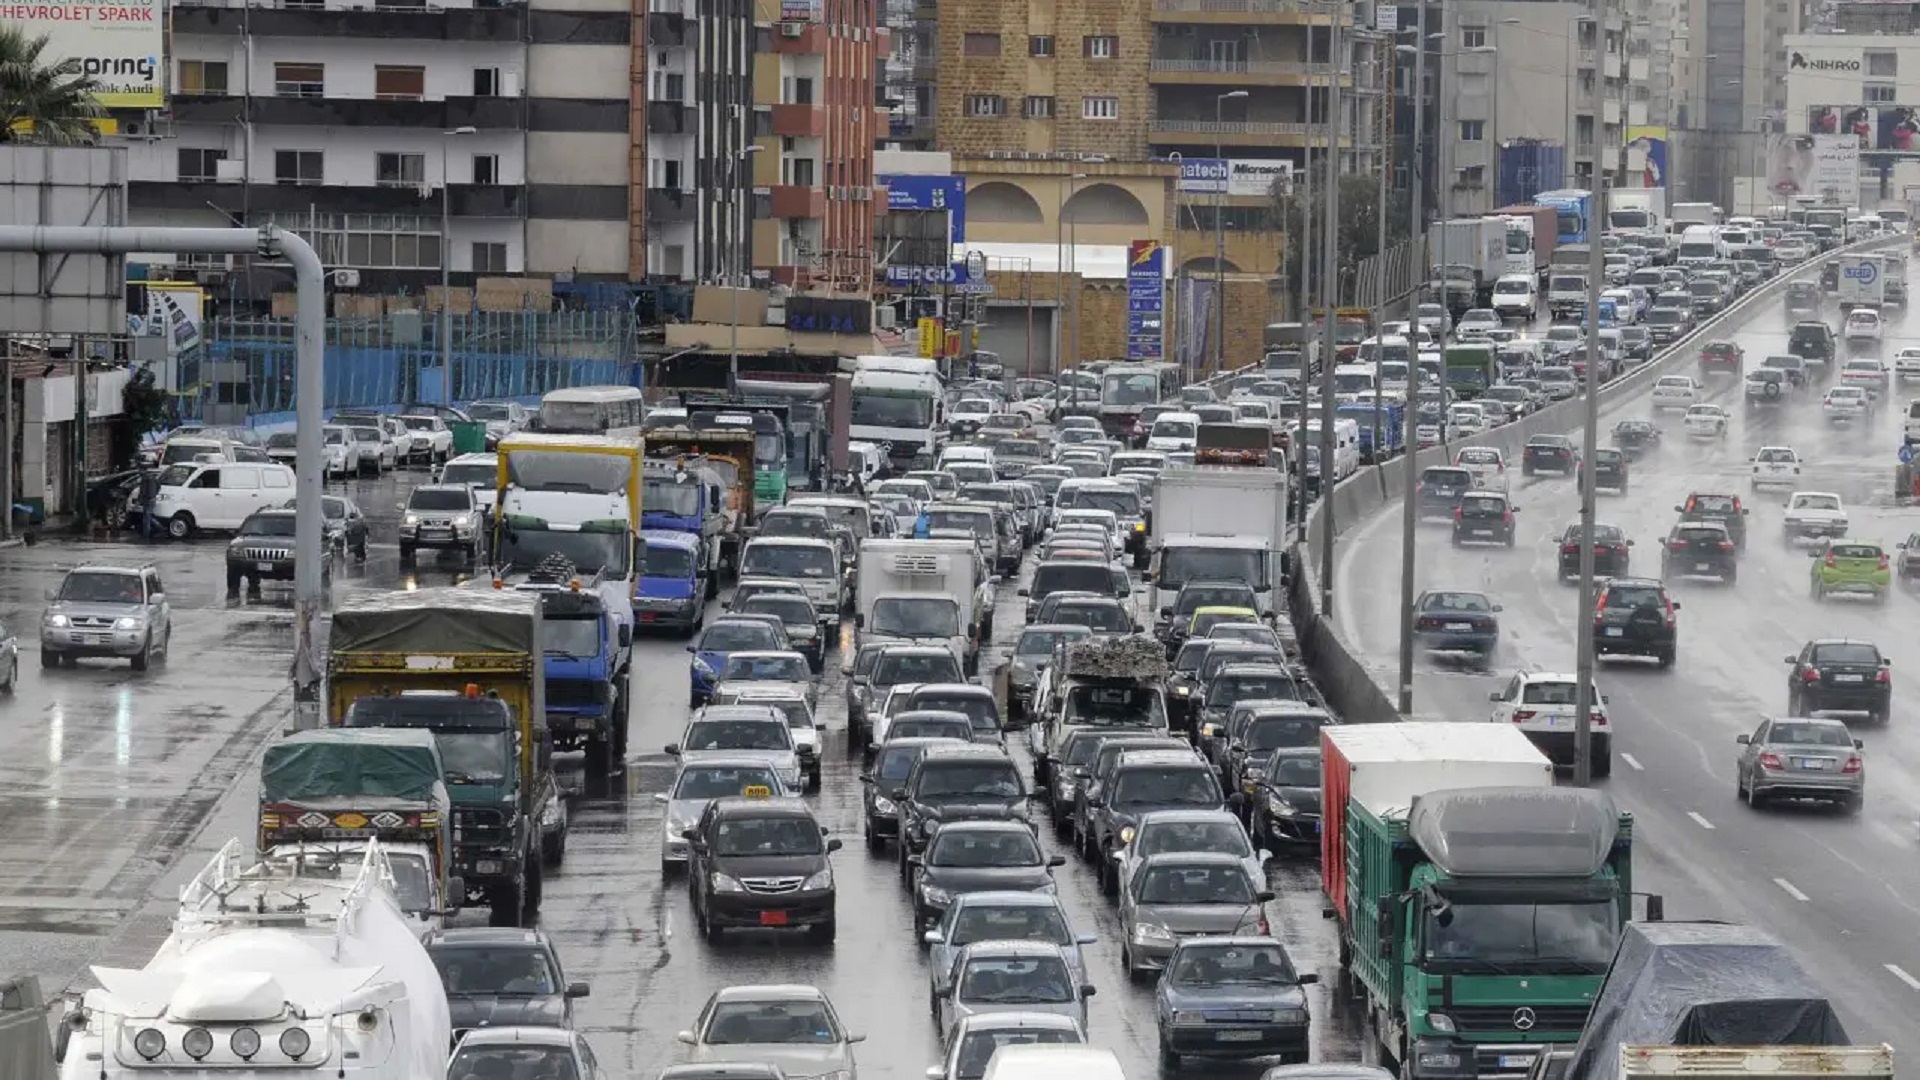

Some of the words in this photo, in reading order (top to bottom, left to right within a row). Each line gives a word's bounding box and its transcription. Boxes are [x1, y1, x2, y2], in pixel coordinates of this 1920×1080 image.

[0, 6, 92, 20] HEVROLET
[99, 7, 152, 21] SPARK
[123, 83, 153, 94] Audi
[1233, 164, 1287, 174] Microsoft
